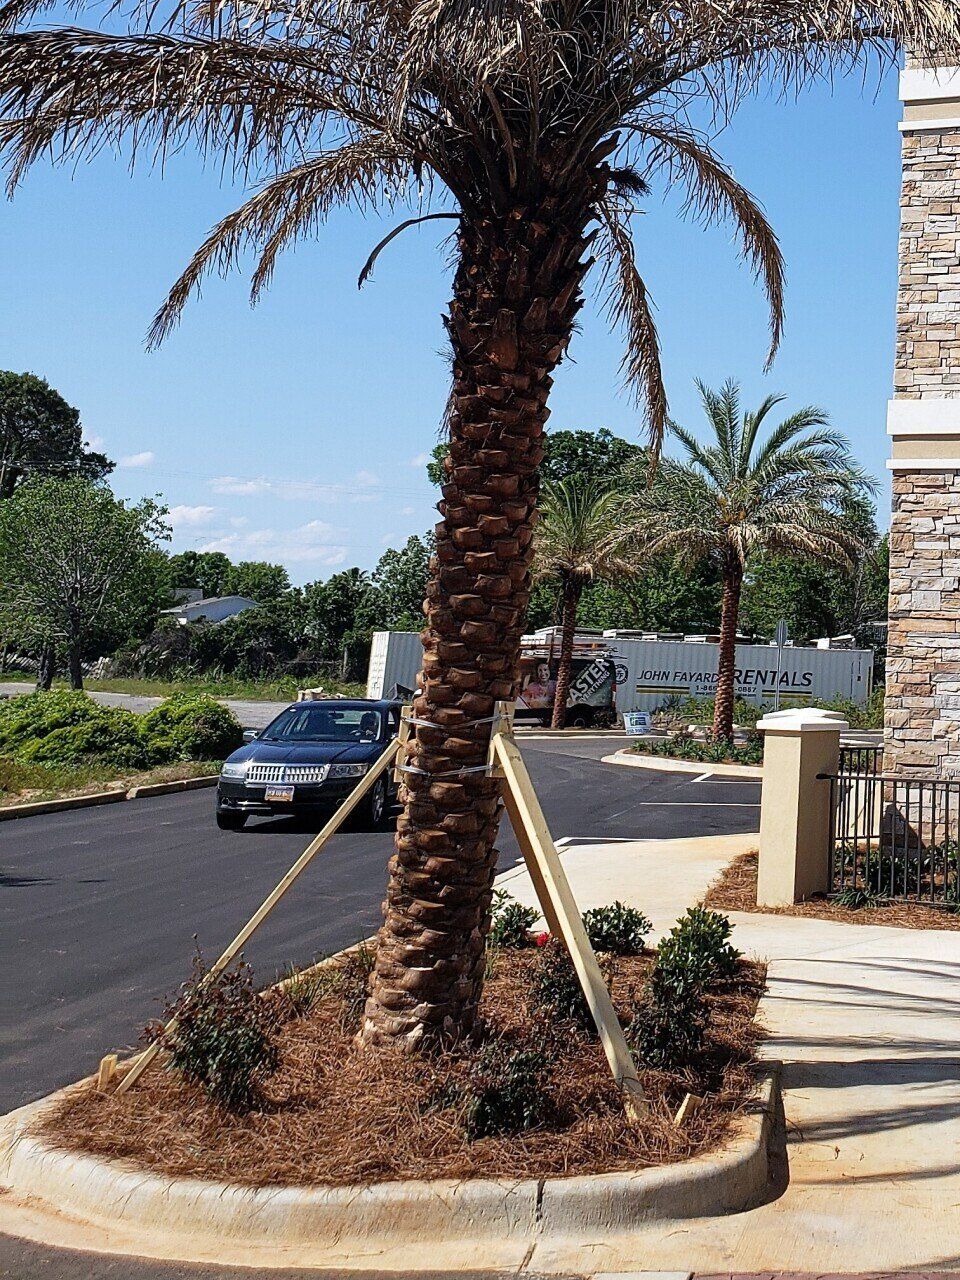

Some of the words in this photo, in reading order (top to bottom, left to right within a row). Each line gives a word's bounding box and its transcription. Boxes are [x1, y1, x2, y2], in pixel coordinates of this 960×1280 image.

[568, 659, 611, 703] ASTER
[637, 670, 670, 681] JOHN
[673, 671, 719, 683] FAYARD
[733, 669, 813, 687] RENTALS
